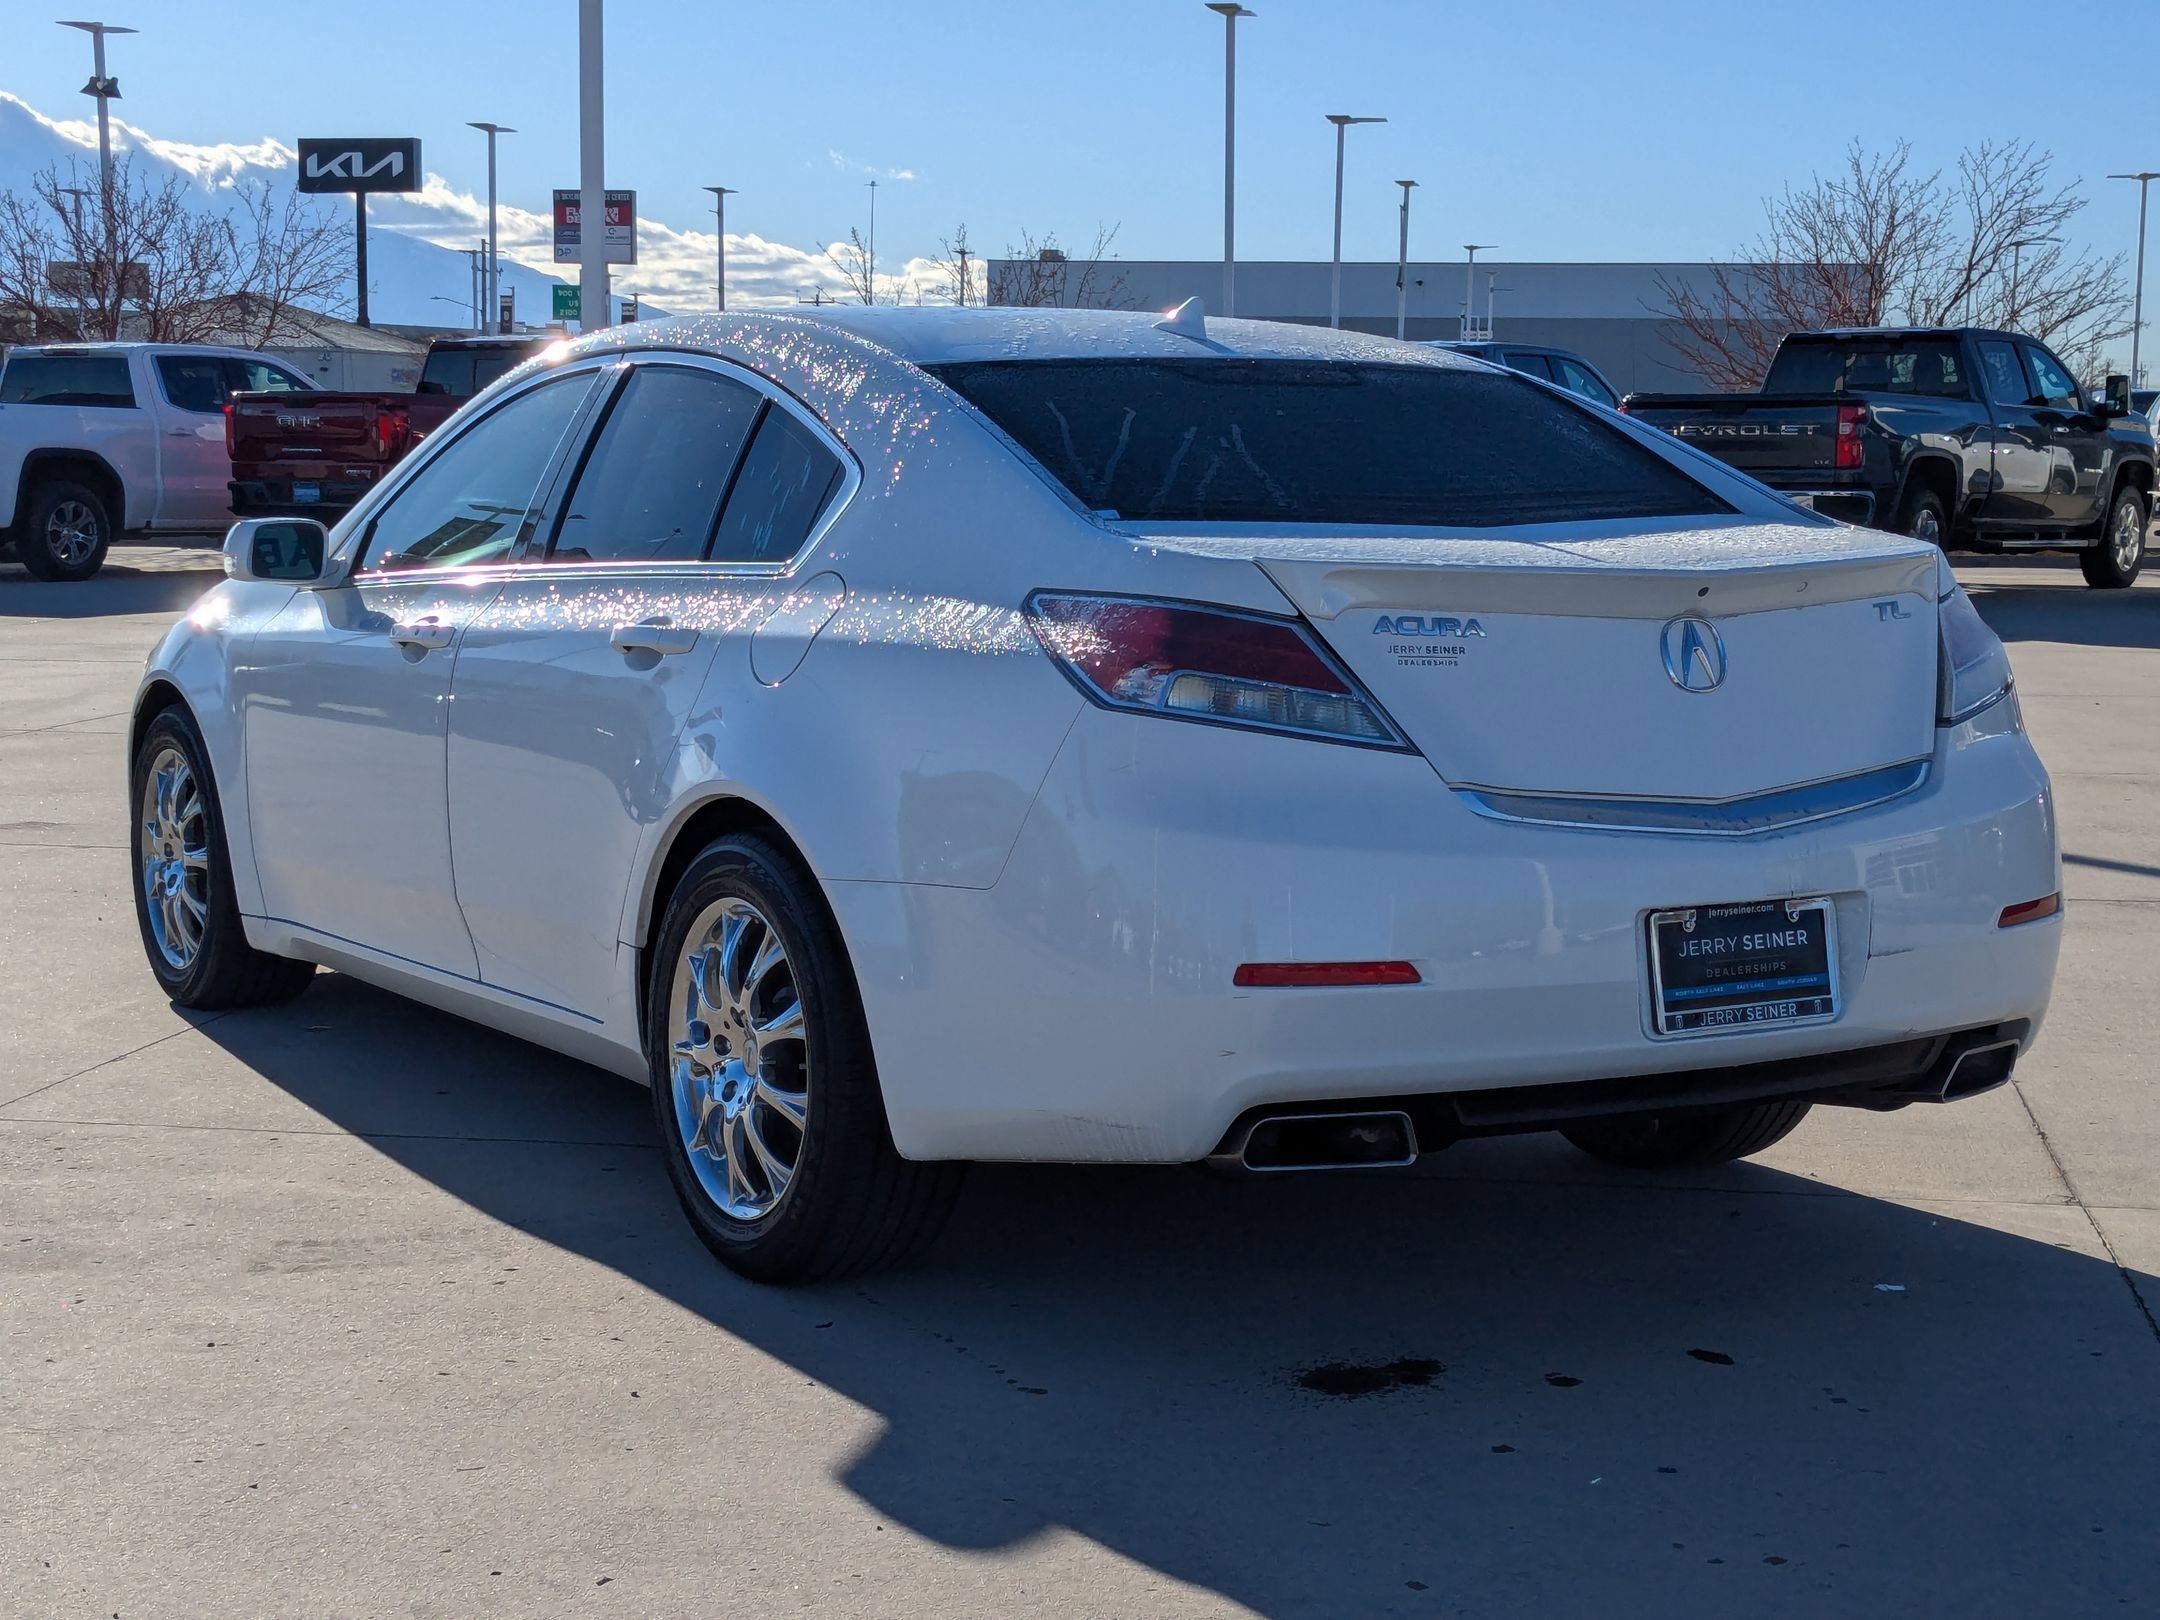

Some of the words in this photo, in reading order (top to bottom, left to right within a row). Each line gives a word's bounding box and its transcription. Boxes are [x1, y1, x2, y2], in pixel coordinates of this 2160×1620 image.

[306, 151, 404, 178] KIA
[1659, 424, 1821, 436] HEVROLET
[1872, 600, 1912, 622] TL
[1372, 615, 1488, 638] ACURA
[1387, 645, 1423, 655] JERRY
[1425, 645, 1466, 655] SEINER
[1397, 659, 1459, 667] DEALERSHIPS
[1708, 904, 1775, 919] jerryseiner.com
[1678, 935, 1738, 958] JERRY
[1742, 929, 1809, 951] SEINER
[1705, 960, 1788, 978] DEALERSHIPS
[1700, 1008, 1747, 1026] JERRY
[1746, 1003, 1798, 1021] SEINER
